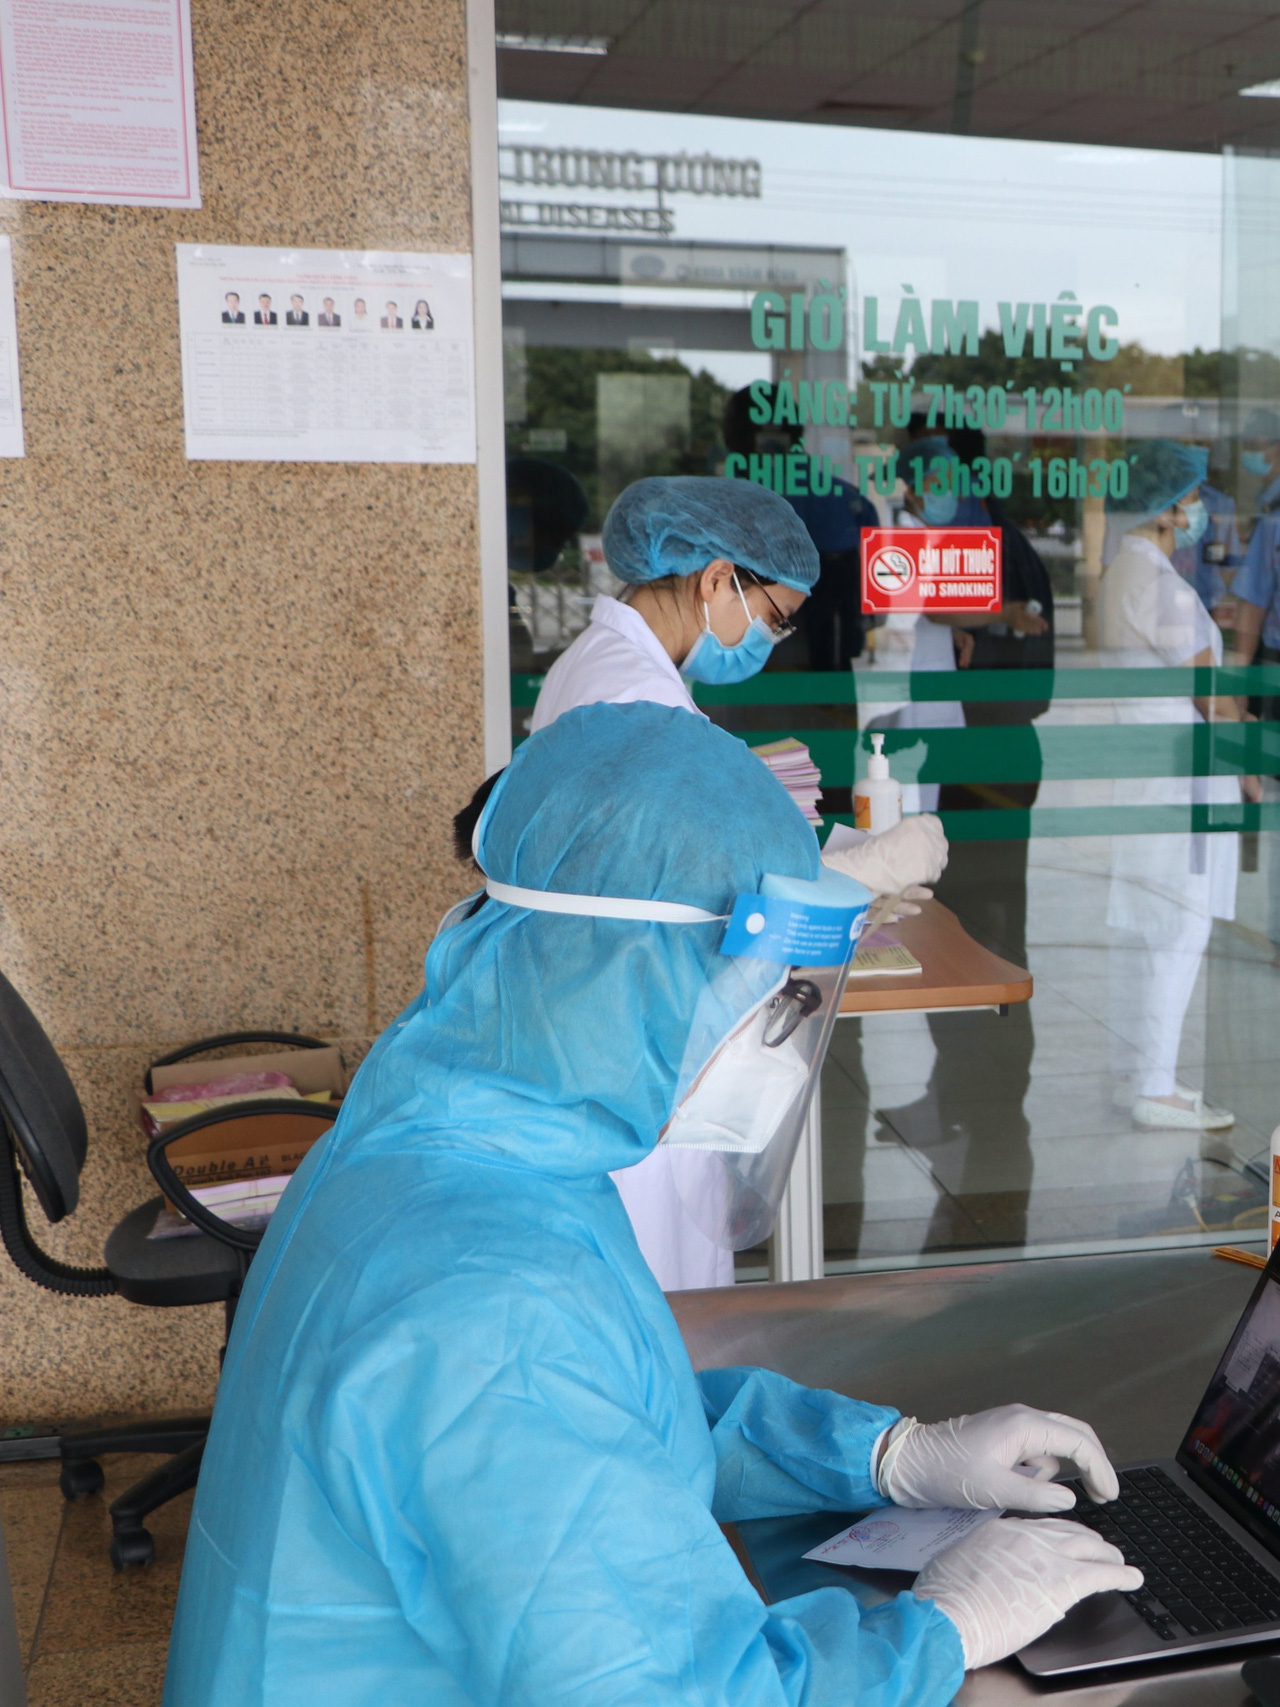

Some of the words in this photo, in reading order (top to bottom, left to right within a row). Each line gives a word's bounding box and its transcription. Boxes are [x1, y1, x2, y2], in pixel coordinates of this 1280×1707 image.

[751, 278, 847, 351] GIỜ
[863, 284, 979, 357] LÀM
[998, 290, 1119, 371] VIỆC
[749, 368, 858, 427] SÁNG:
[869, 369, 914, 429] TỪ
[724, 437, 842, 497] CHIỀU:
[855, 443, 899, 497] TỪ
[919, 582, 936, 597] NO
[940, 582, 994, 597] SMOKING
[174, 1160, 237, 1175] Double
